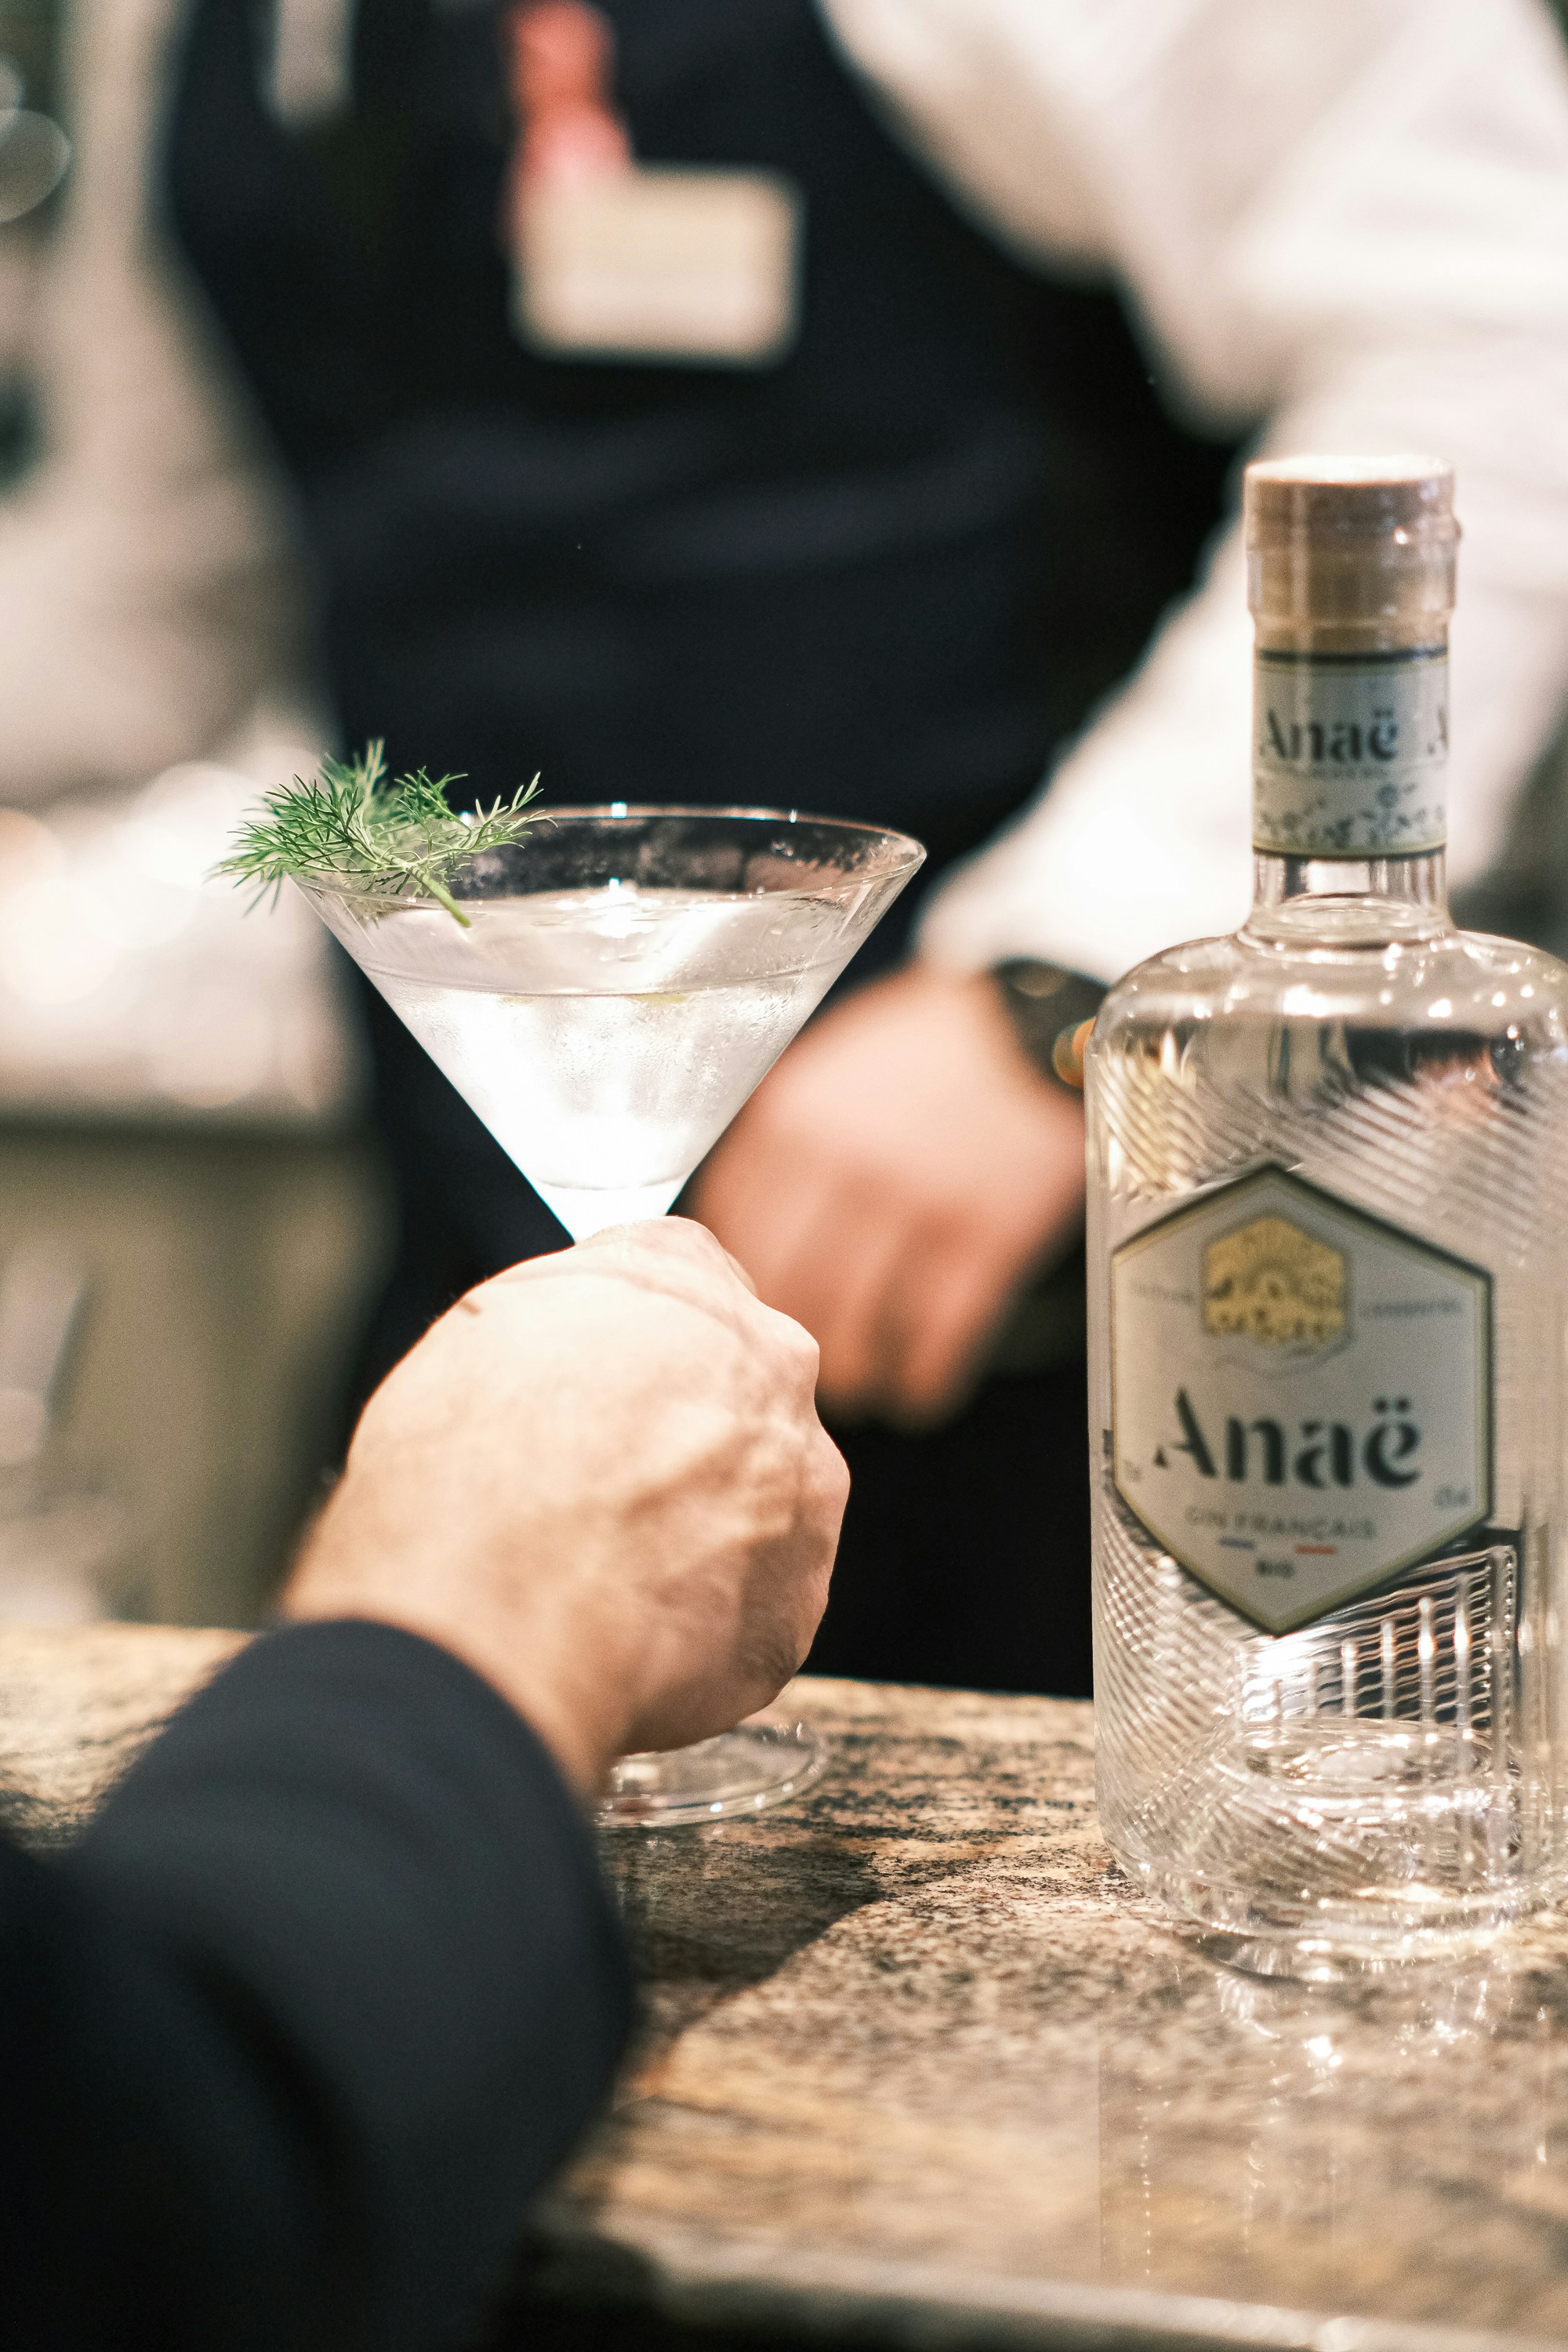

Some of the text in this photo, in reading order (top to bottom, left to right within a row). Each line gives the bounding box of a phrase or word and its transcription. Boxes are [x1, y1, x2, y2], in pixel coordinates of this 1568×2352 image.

[1259, 707, 1399, 762] Anaë
[1153, 1386, 1421, 1488] Anaë
[1185, 1505, 1228, 1529] GIN
